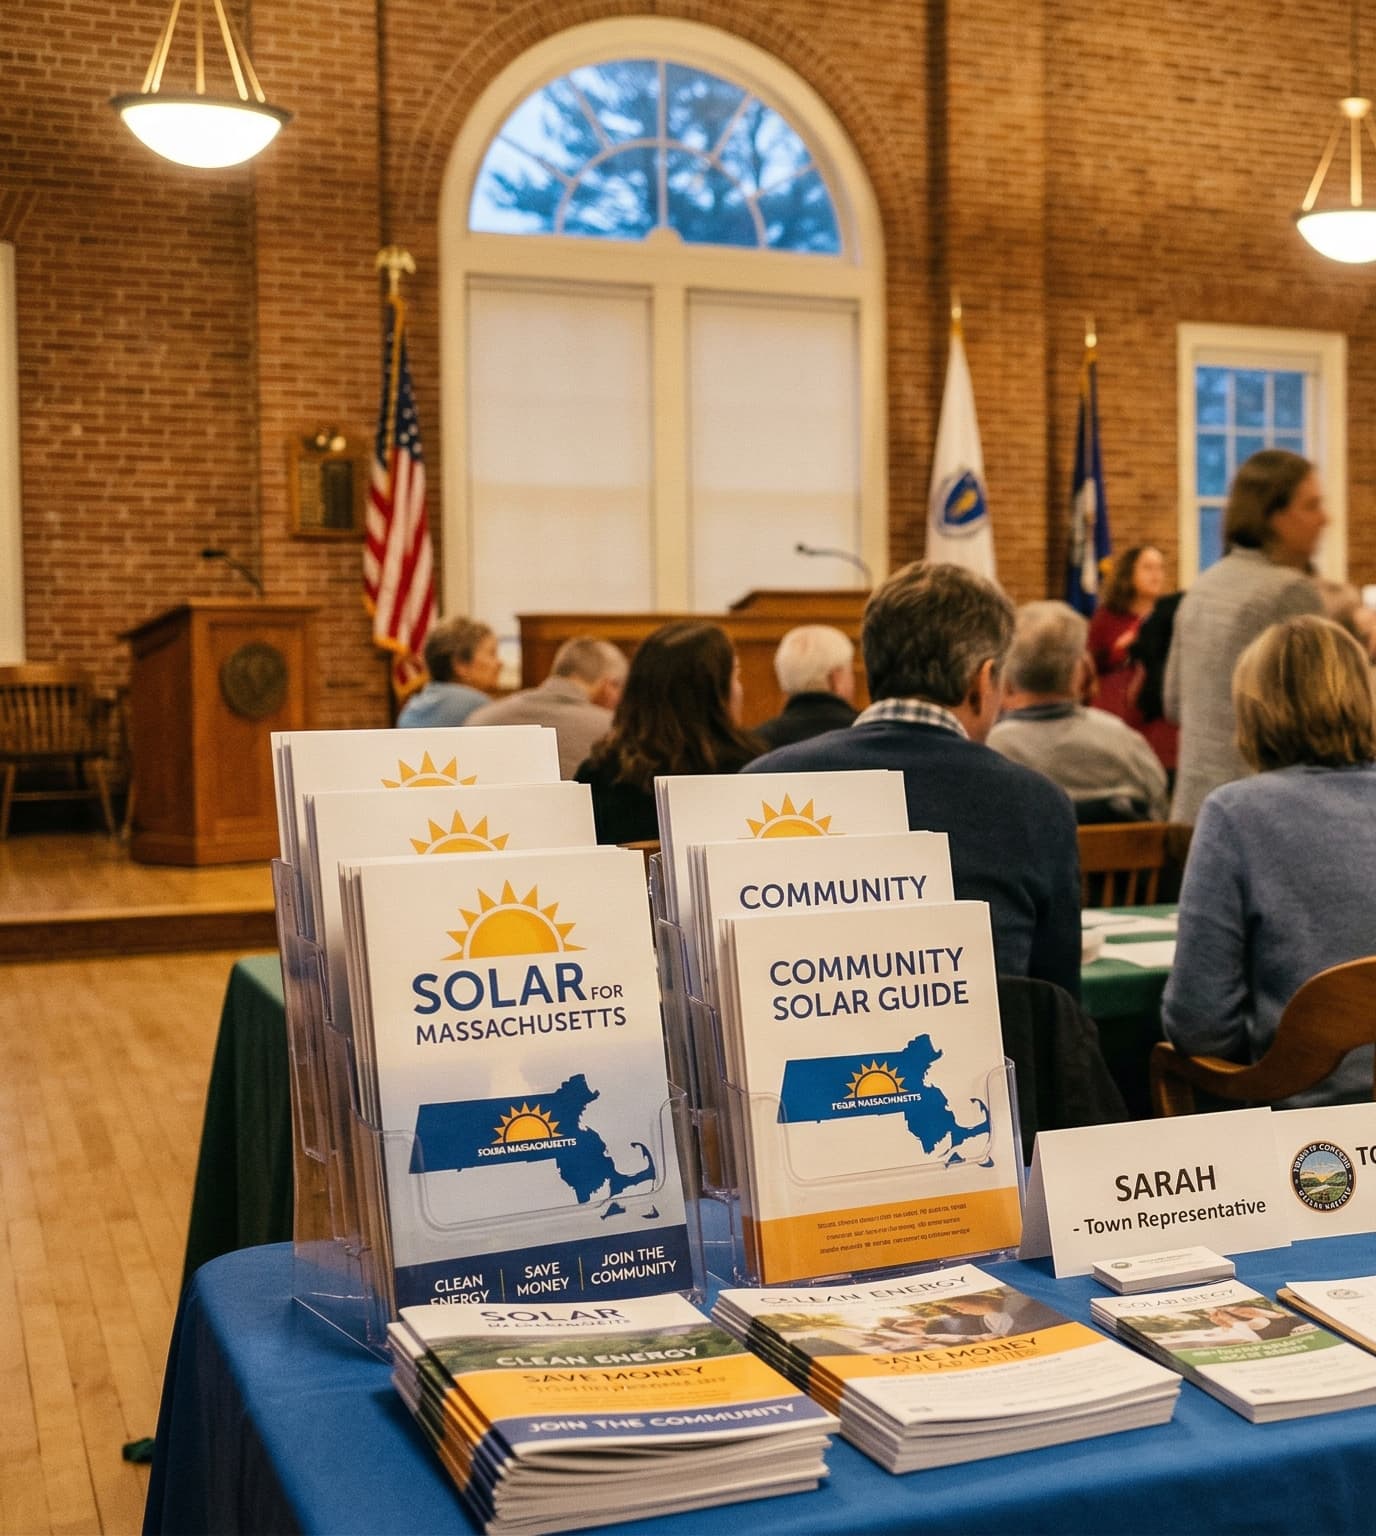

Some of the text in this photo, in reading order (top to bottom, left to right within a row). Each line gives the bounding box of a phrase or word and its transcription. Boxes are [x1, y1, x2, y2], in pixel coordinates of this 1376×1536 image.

[739, 875, 927, 910] COMMUNITY
[769, 946, 964, 986] COMMUNITY
[412, 961, 623, 1015] SOLAR FOR
[772, 980, 969, 1021] SOLAR GUIDE
[416, 1006, 627, 1045] MASSACHUSETTS
[1115, 1164, 1217, 1202] SARAH
[1084, 1214, 1132, 1235] Town
[1138, 1198, 1266, 1230] Representative
[601, 1246, 665, 1268] JOIN THE
[434, 1273, 483, 1293] CLEAN
[524, 1262, 560, 1280] SAVE
[591, 1260, 678, 1285] COMMUNITY
[517, 1277, 570, 1297] MONEY
[869, 1275, 966, 1299] ENERGY
[480, 1308, 626, 1323] SOLAR
[496, 1347, 698, 1367] CLEAN ENERGY
[873, 1353, 941, 1366] SAVE
[945, 1337, 1038, 1360] MONEY
[523, 1365, 704, 1383] SAVE MONEY
[527, 1402, 795, 1433] JOIN THE COMMUNITY
